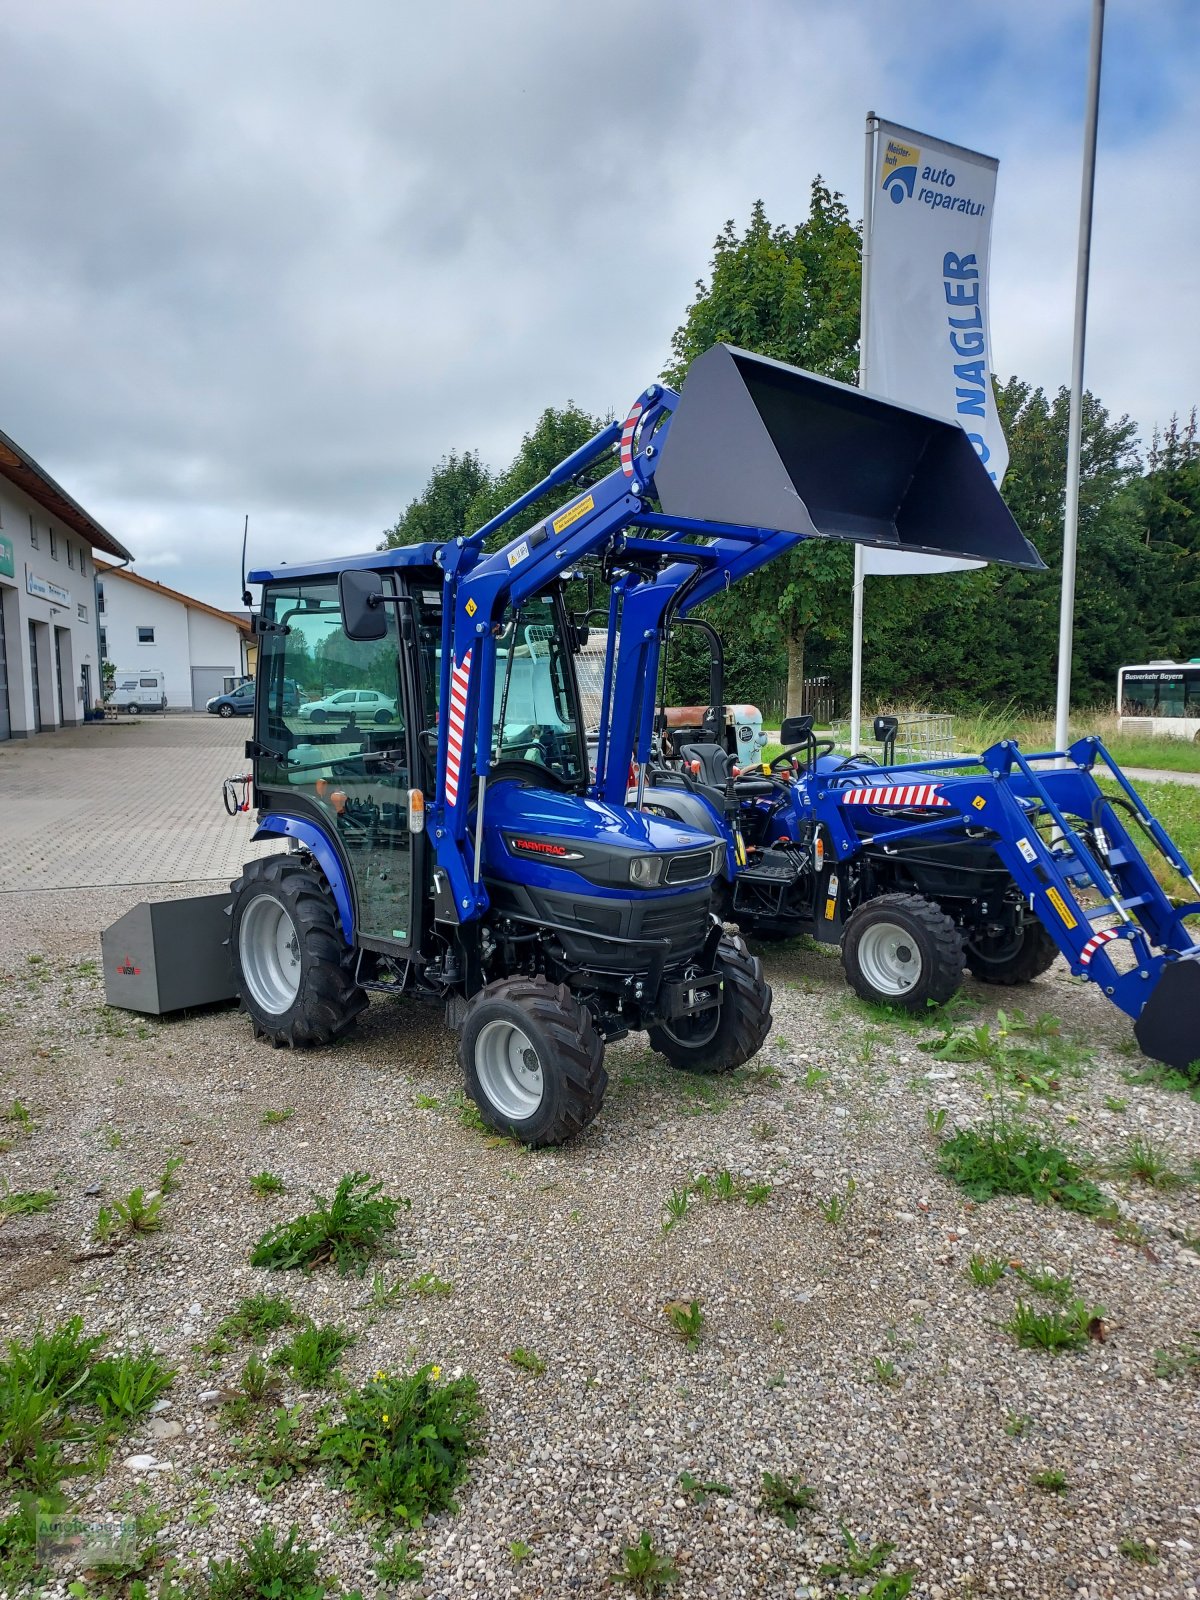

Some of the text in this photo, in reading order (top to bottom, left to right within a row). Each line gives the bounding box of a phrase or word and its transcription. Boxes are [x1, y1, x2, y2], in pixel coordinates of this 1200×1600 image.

[888, 141, 911, 157] Meister-
[922, 166, 956, 187] auto
[943, 251, 986, 418] NAGLER
[1160, 672, 1183, 680] Bayern
[517, 840, 565, 855] FARMTRAC
